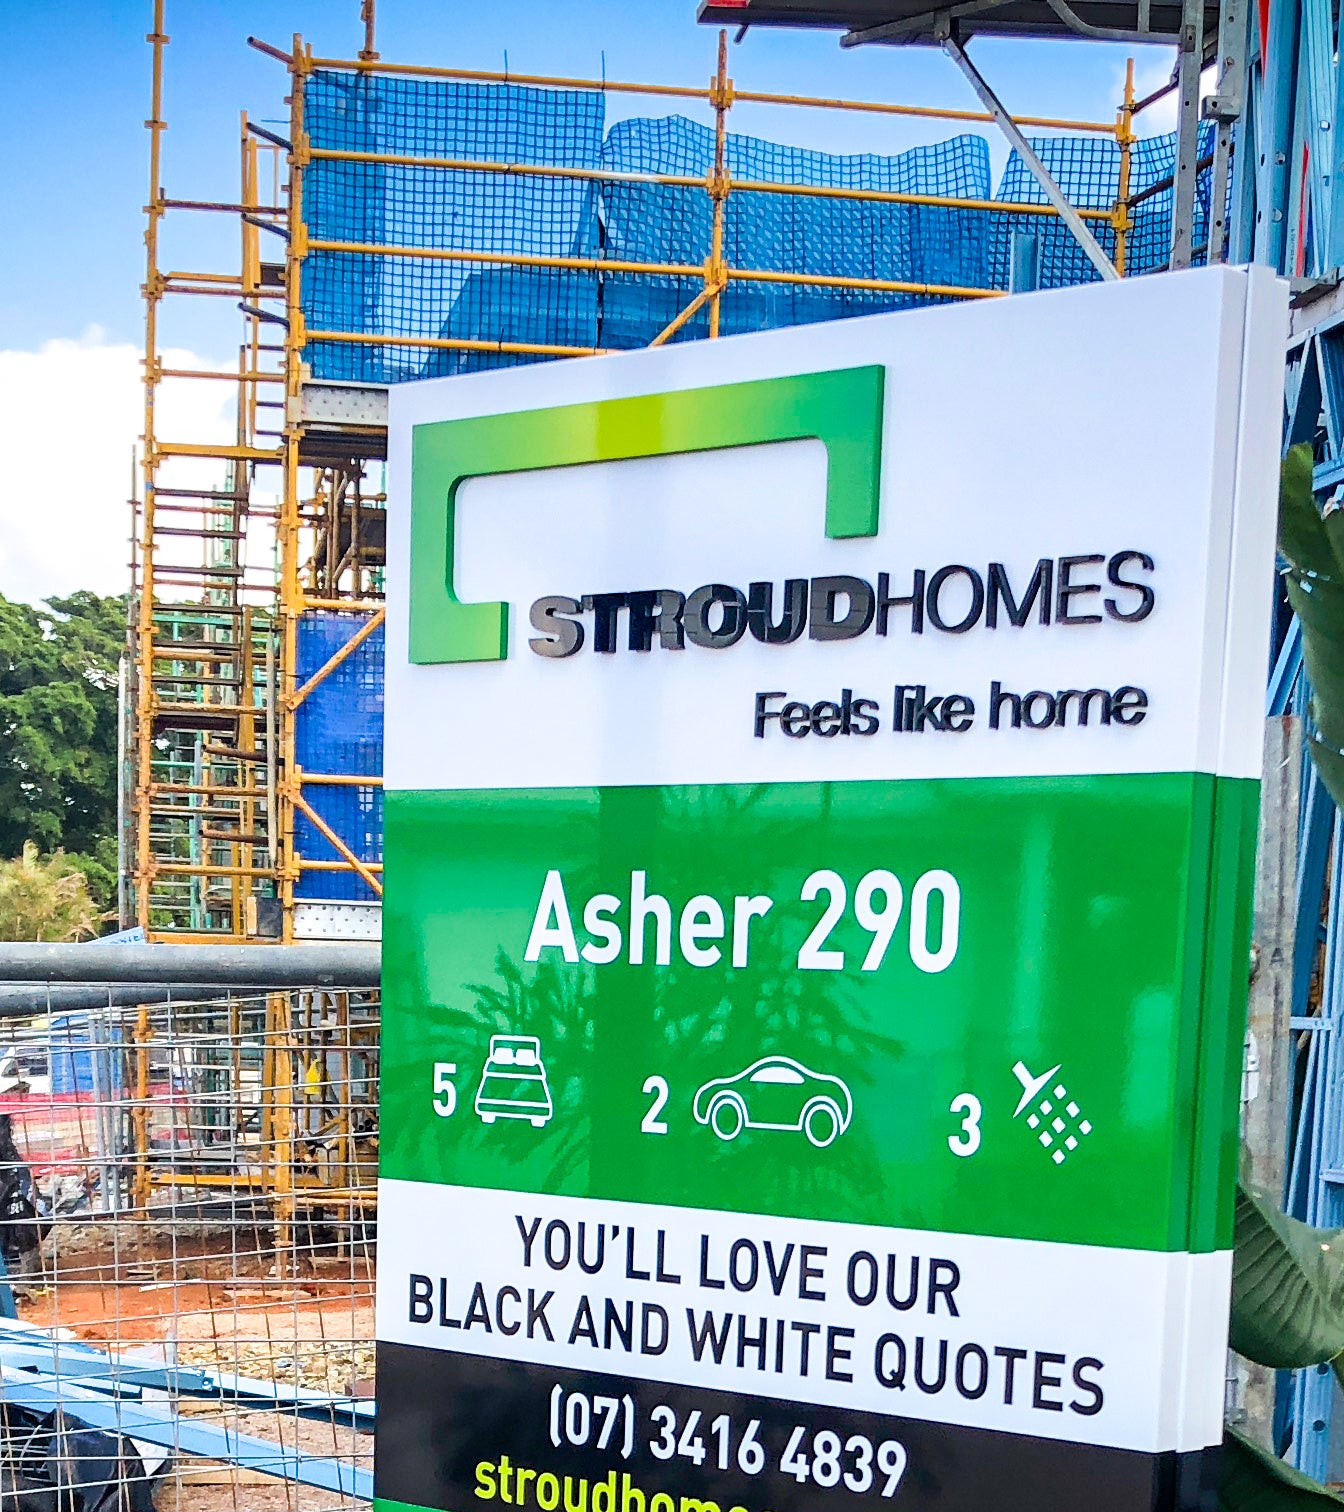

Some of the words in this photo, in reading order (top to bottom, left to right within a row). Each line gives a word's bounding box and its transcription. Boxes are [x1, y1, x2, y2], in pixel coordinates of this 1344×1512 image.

[528, 550, 1156, 658] STROUDHOMES
[753, 686, 879, 738] Feels
[893, 684, 974, 733] like
[989, 680, 1148, 729] home
[524, 868, 773, 967] Asher
[797, 868, 962, 973] 290
[432, 1062, 457, 1117] 5
[640, 1075, 669, 1134] 2
[948, 1093, 982, 1157] 3
[515, 1214, 681, 1285] YOU'LL
[699, 1234, 827, 1300] LOVE
[847, 1250, 961, 1317] OUR
[408, 1273, 555, 1342] BLACK
[569, 1294, 669, 1356] AND
[687, 1308, 853, 1383] WHITE
[874, 1332, 1105, 1416] QUOTES
[547, 1384, 635, 1459] (07)
[650, 1405, 765, 1475] 3416
[778, 1427, 907, 1499] 4839
